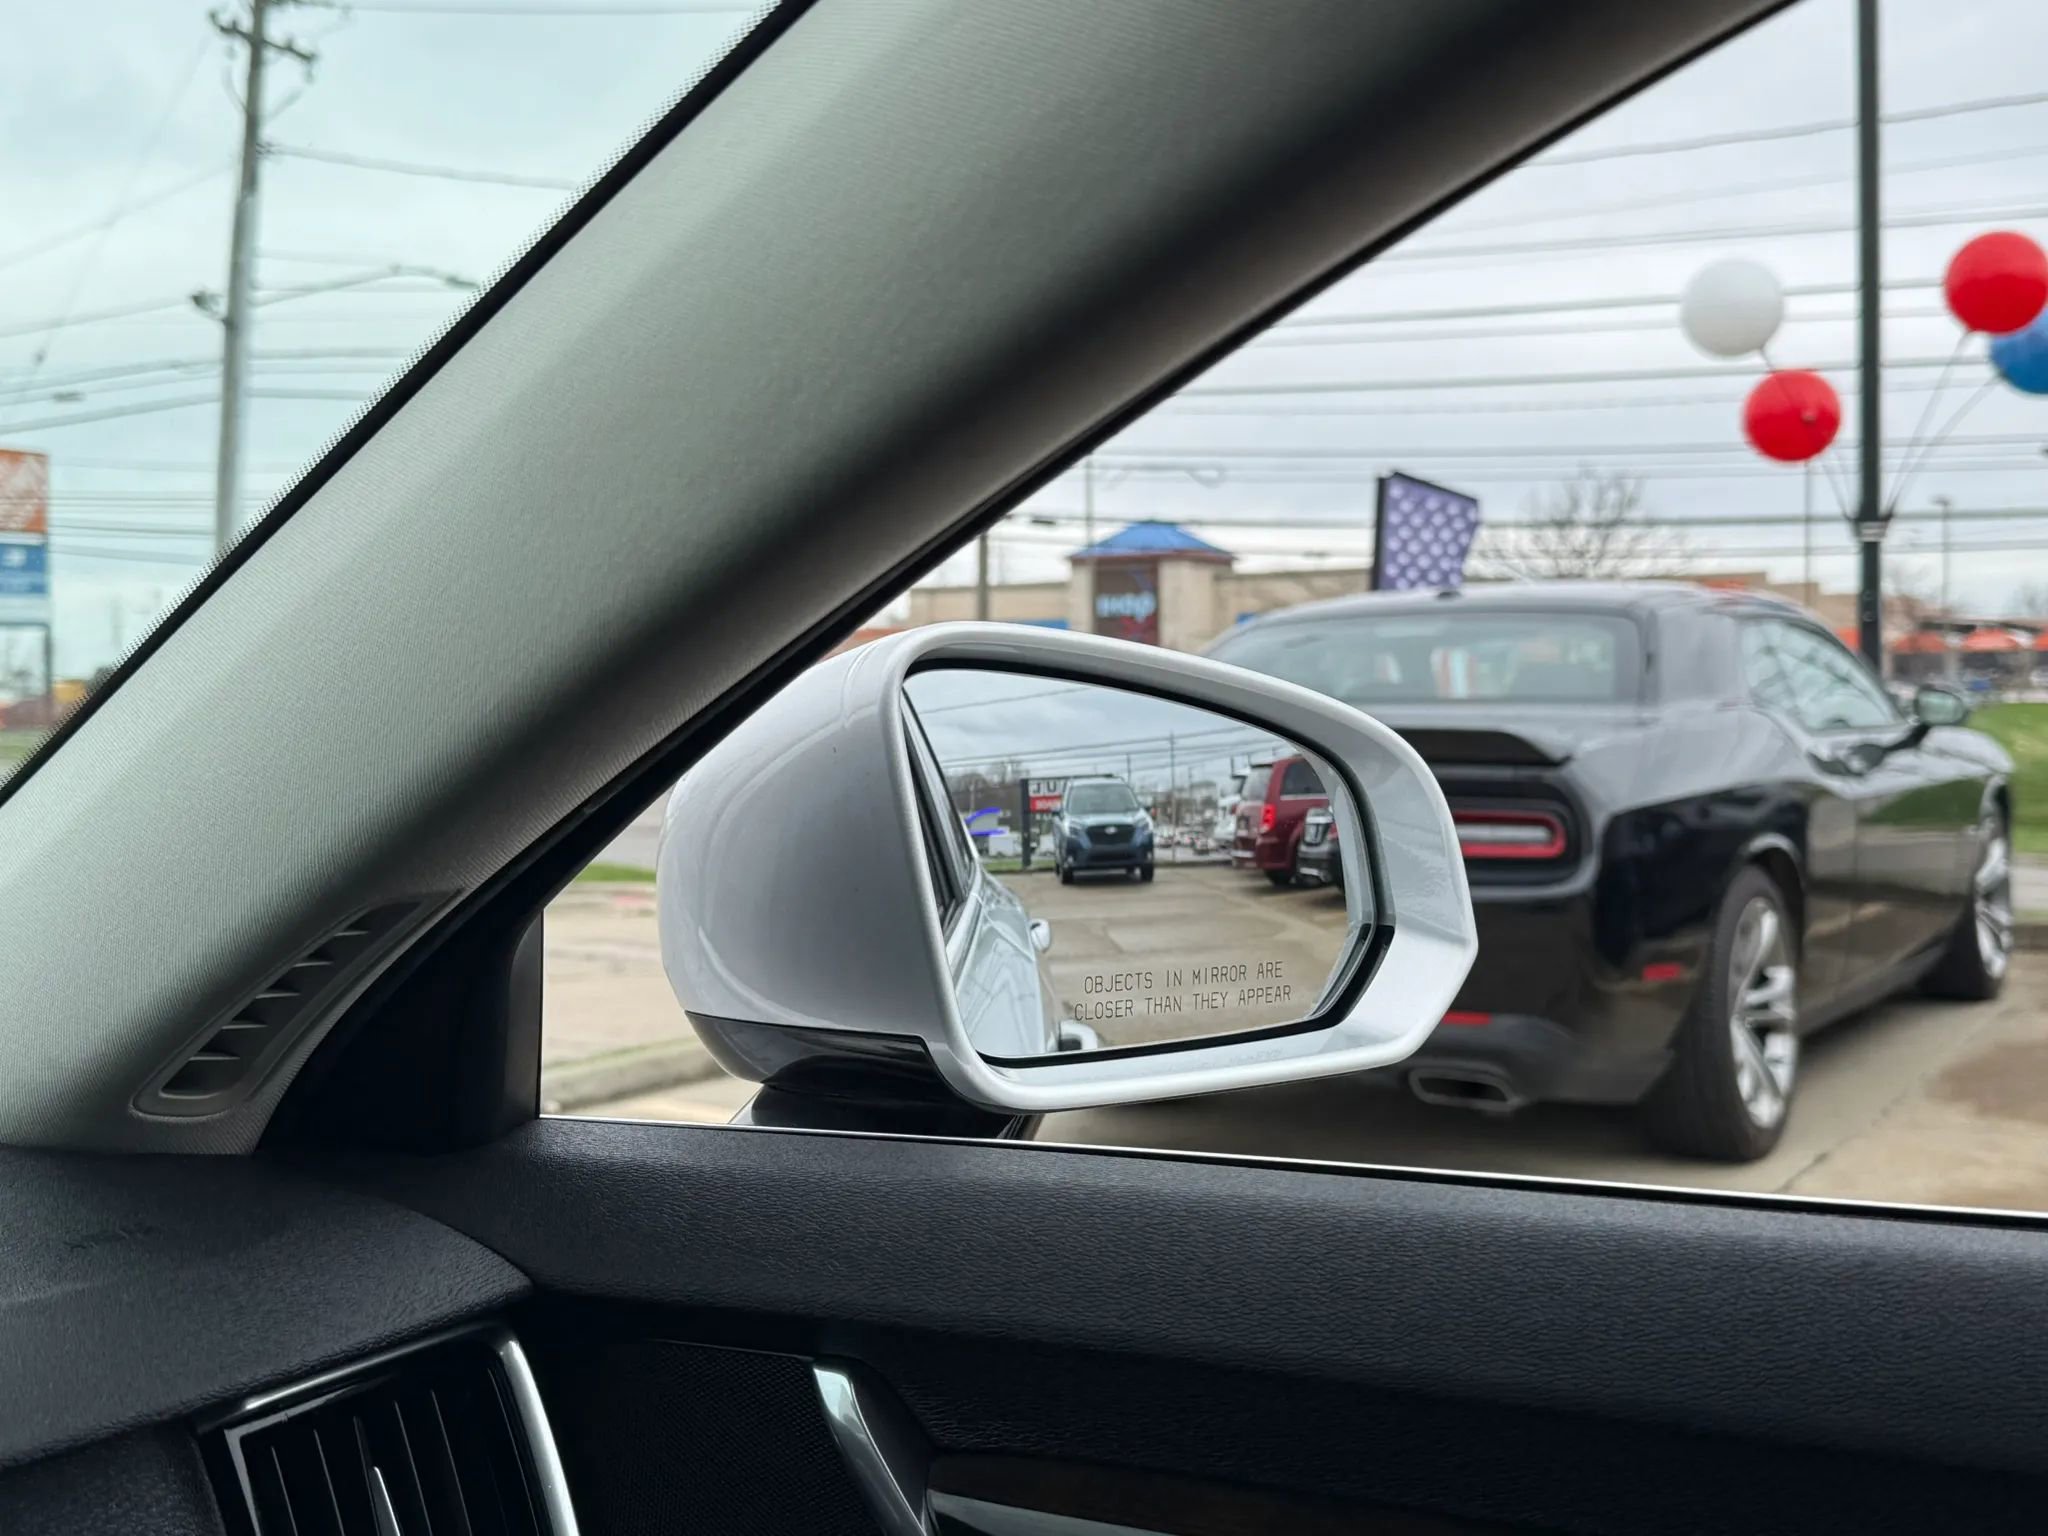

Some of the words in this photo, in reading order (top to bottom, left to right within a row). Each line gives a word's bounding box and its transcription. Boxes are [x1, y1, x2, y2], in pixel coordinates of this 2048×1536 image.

[1084, 972, 1153, 994] OBJECTS
[1167, 970, 1182, 988] IN
[1192, 965, 1247, 985] MIRROR
[1257, 962, 1283, 980] ARE
[1075, 1000, 1134, 1022] CLOSER
[1146, 996, 1182, 1015] THAN
[1193, 991, 1229, 1010] THEY
[1239, 985, 1292, 1005] APPEAR
